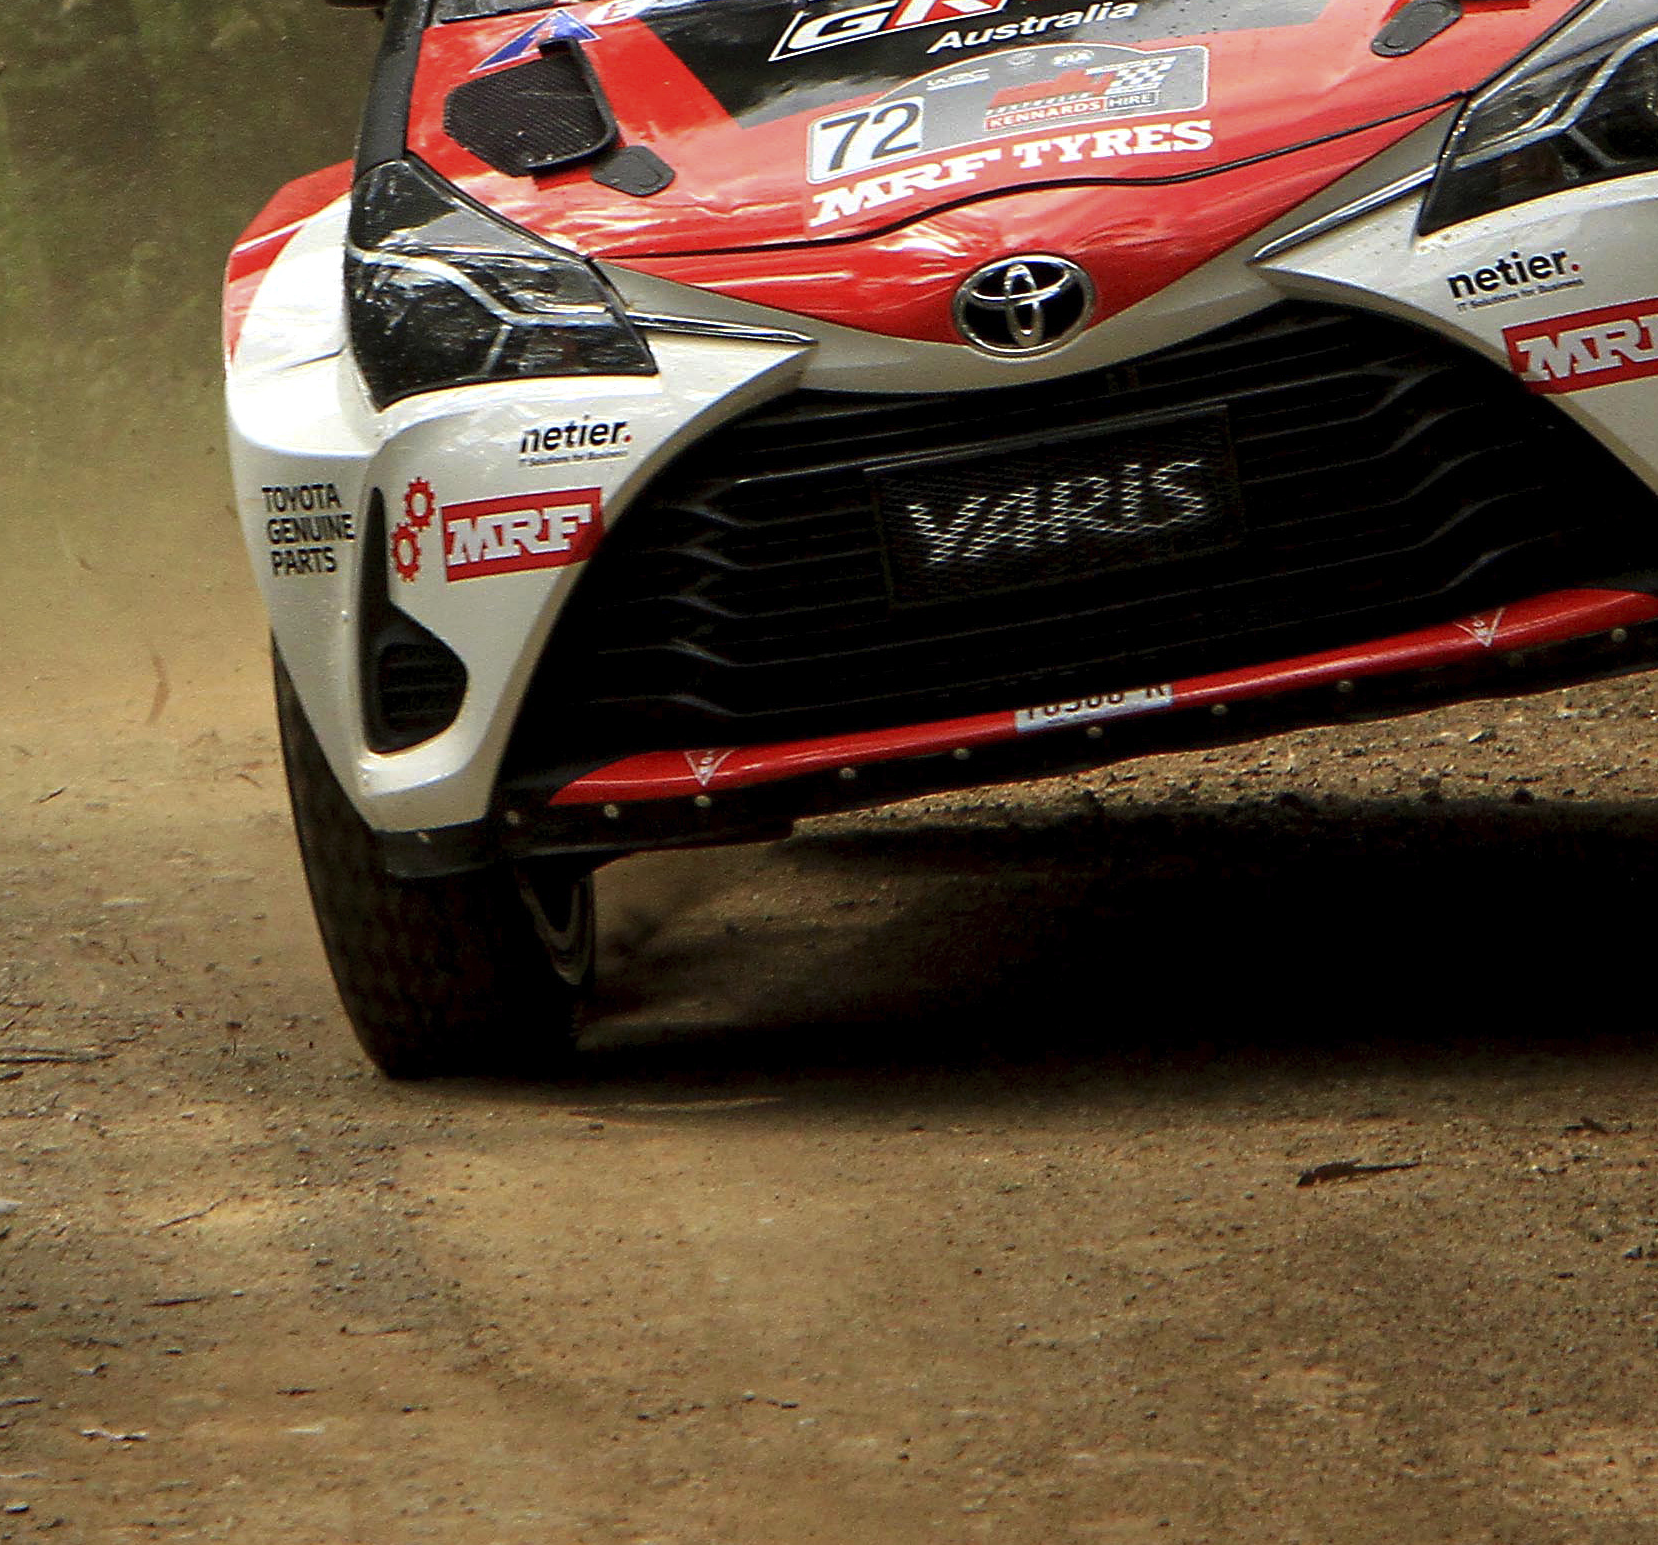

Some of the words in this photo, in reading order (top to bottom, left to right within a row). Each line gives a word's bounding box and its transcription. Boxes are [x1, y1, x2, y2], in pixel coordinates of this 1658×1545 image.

[927, 0, 1139, 54] Australia
[989, 99, 1102, 128] KENNARDS
[1109, 92, 1152, 107] HIRE
[819, 102, 921, 173] 72
[808, 146, 1002, 228] MRF
[1014, 119, 1214, 170] TYRES
[1447, 250, 1581, 298] netier.
[261, 483, 342, 513] TOYOTA
[908, 458, 1207, 567] YARIS
[266, 513, 356, 546] GENUINE
[447, 503, 592, 568] MRF
[271, 546, 338, 578] PARTS
